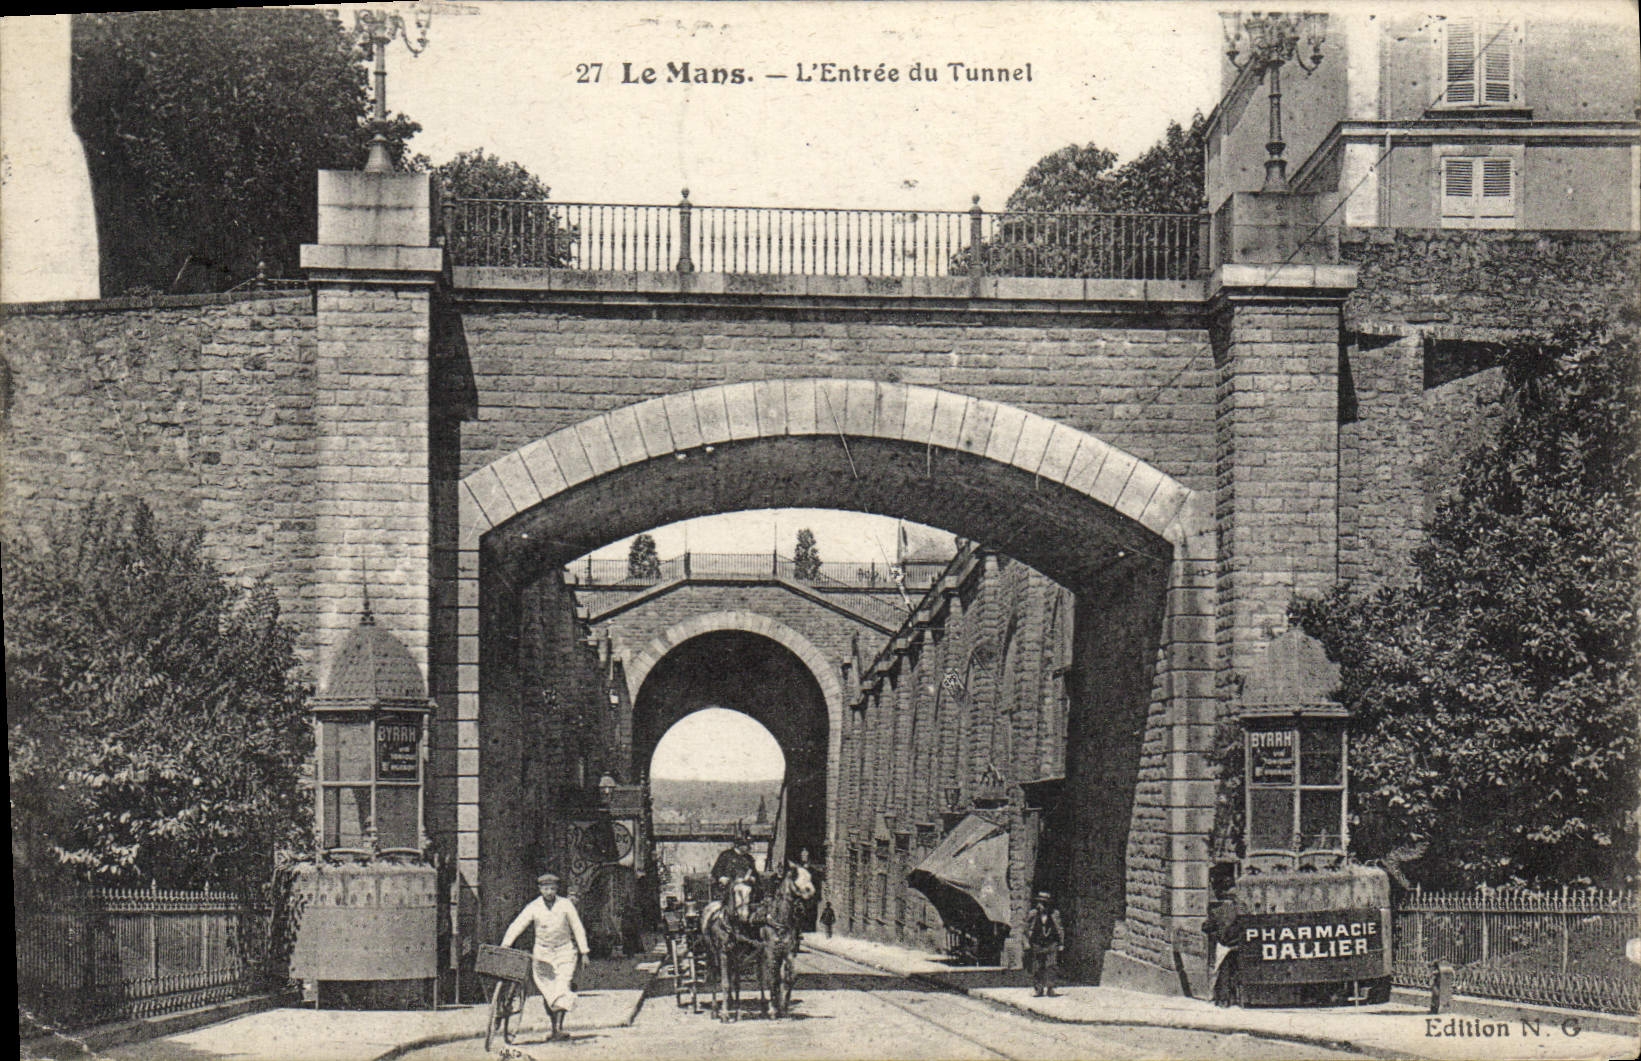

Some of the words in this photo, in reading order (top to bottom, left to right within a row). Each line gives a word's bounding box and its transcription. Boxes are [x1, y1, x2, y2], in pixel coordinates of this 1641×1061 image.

[377, 725, 416, 742] BYRRH
[1250, 731, 1292, 748] BYRRH
[1245, 922, 1377, 942] PHARMACIE
[1261, 938, 1369, 961] DALLIER
